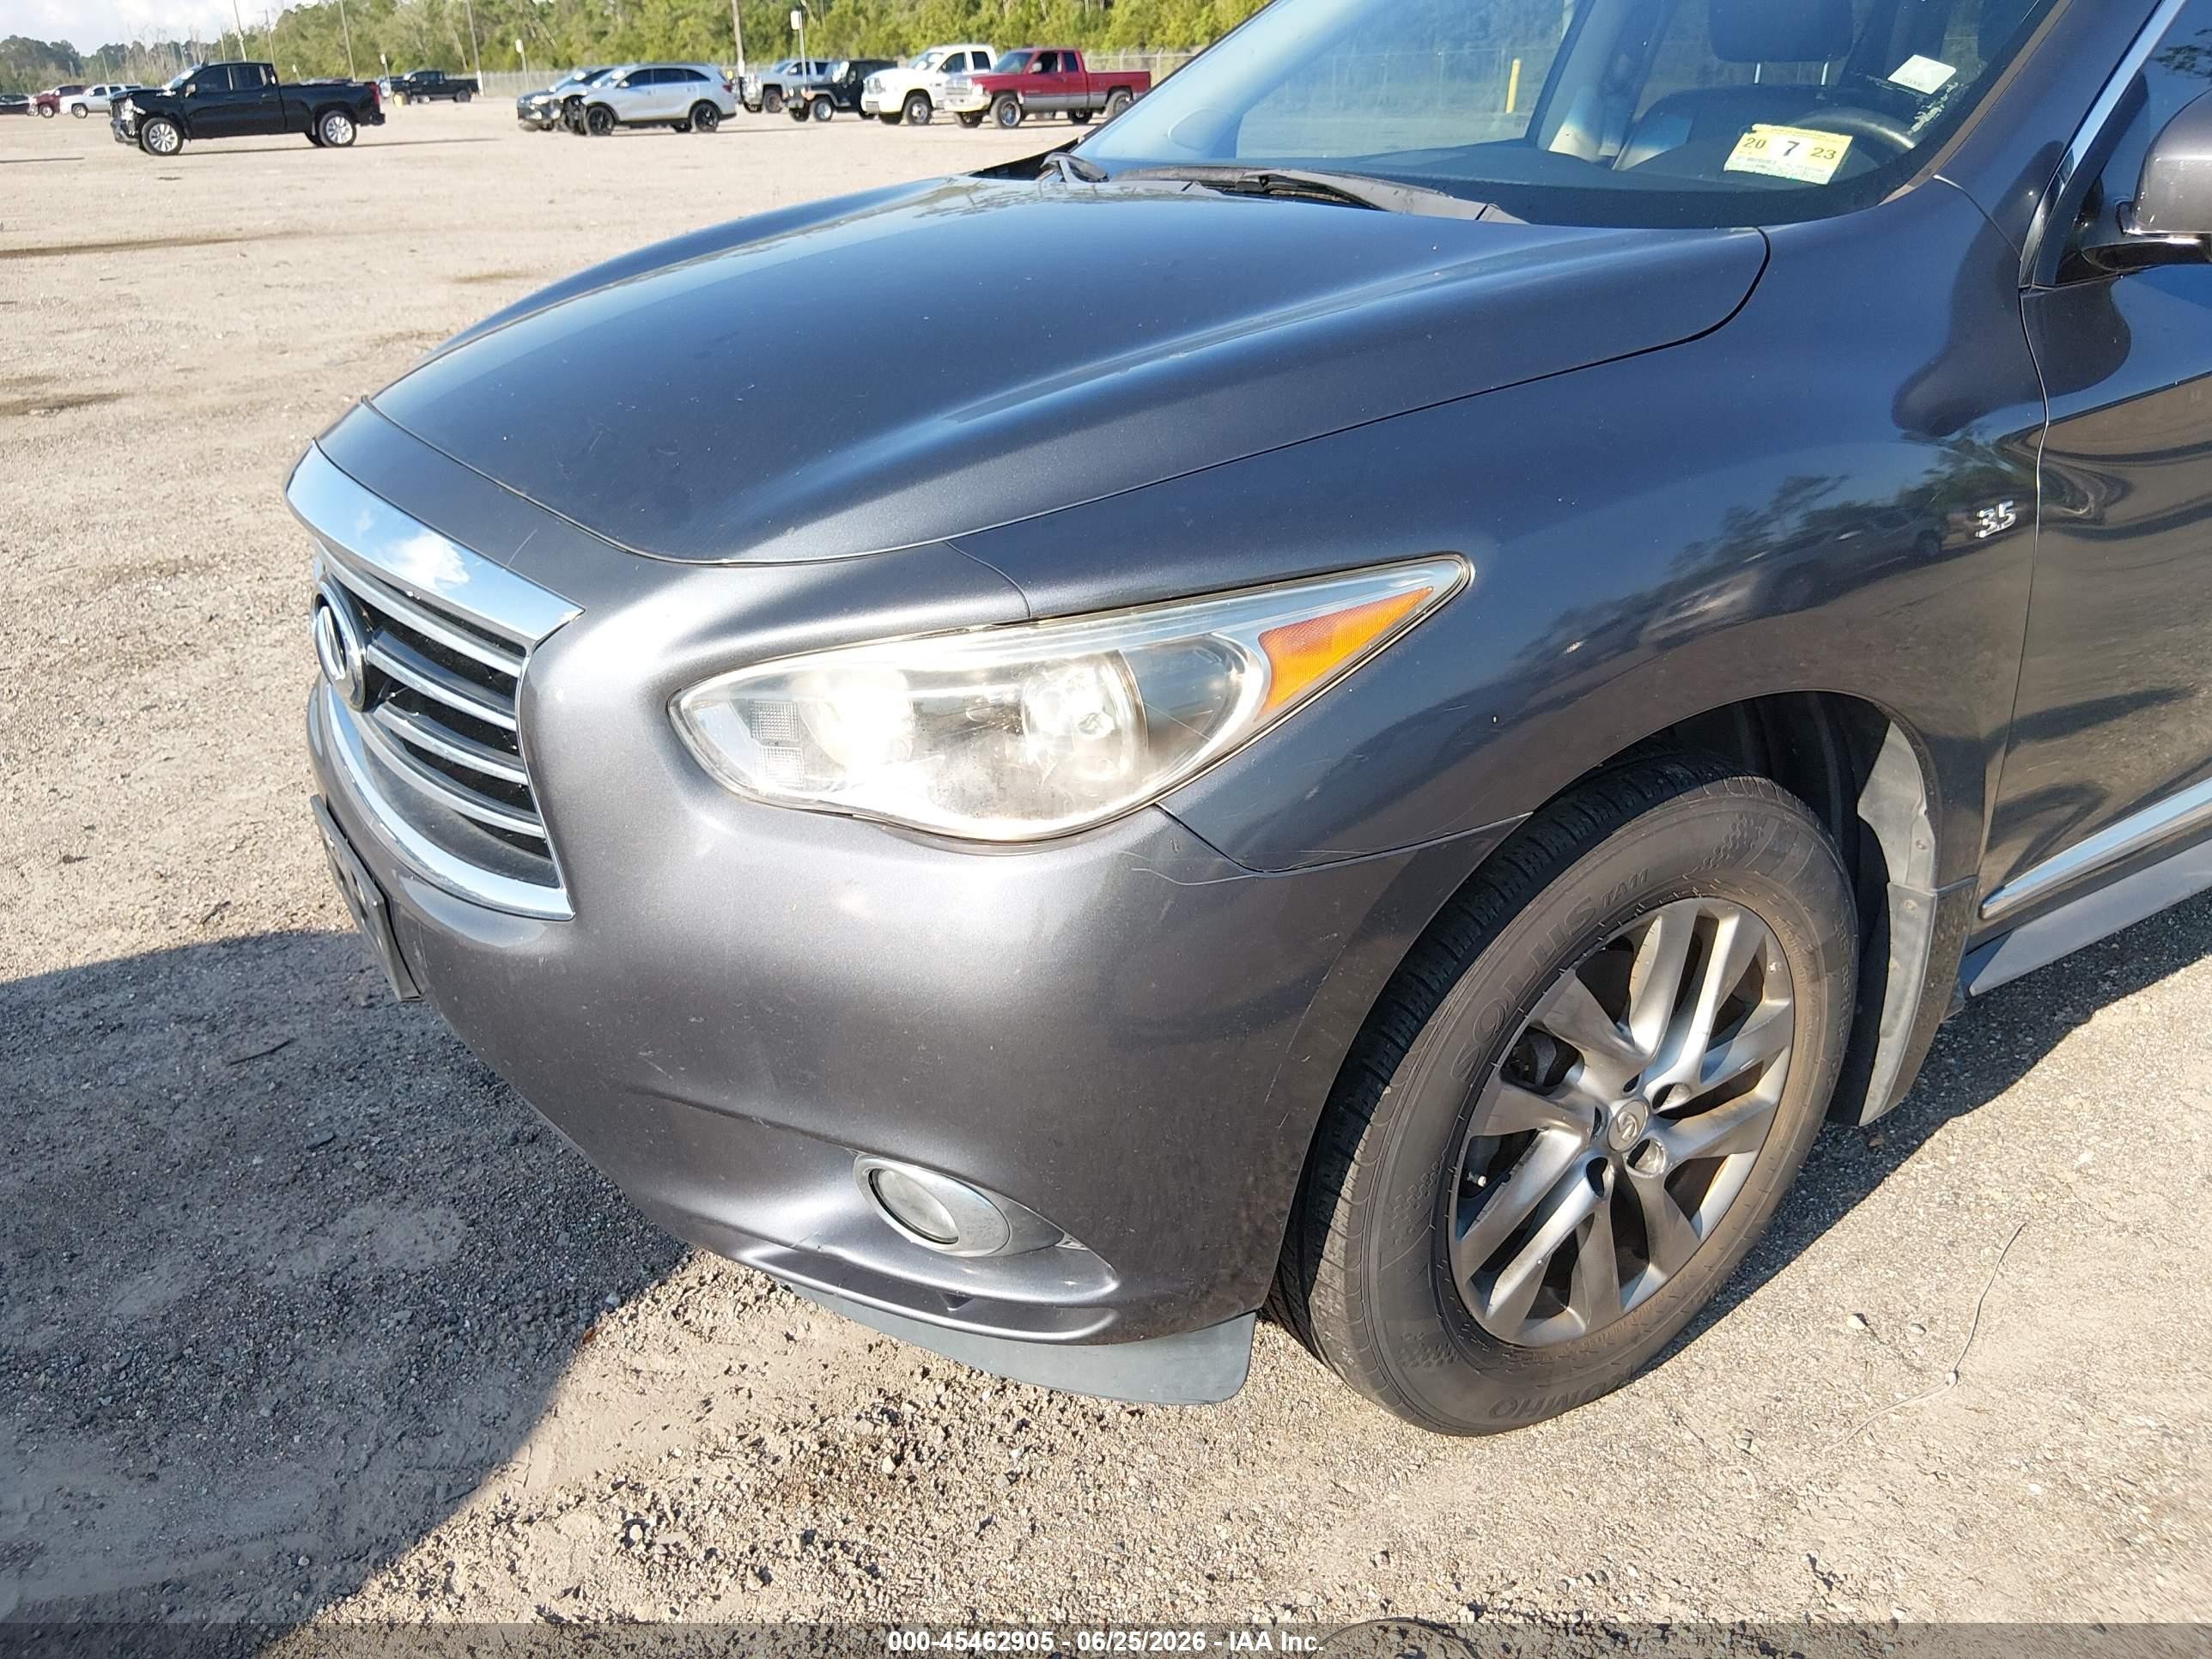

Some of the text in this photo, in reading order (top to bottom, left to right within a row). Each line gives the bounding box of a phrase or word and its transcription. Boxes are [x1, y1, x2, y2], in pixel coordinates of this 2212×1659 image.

[1742, 137, 1837, 160] 20 7 23
[1450, 896, 1595, 1082] SOLUS
